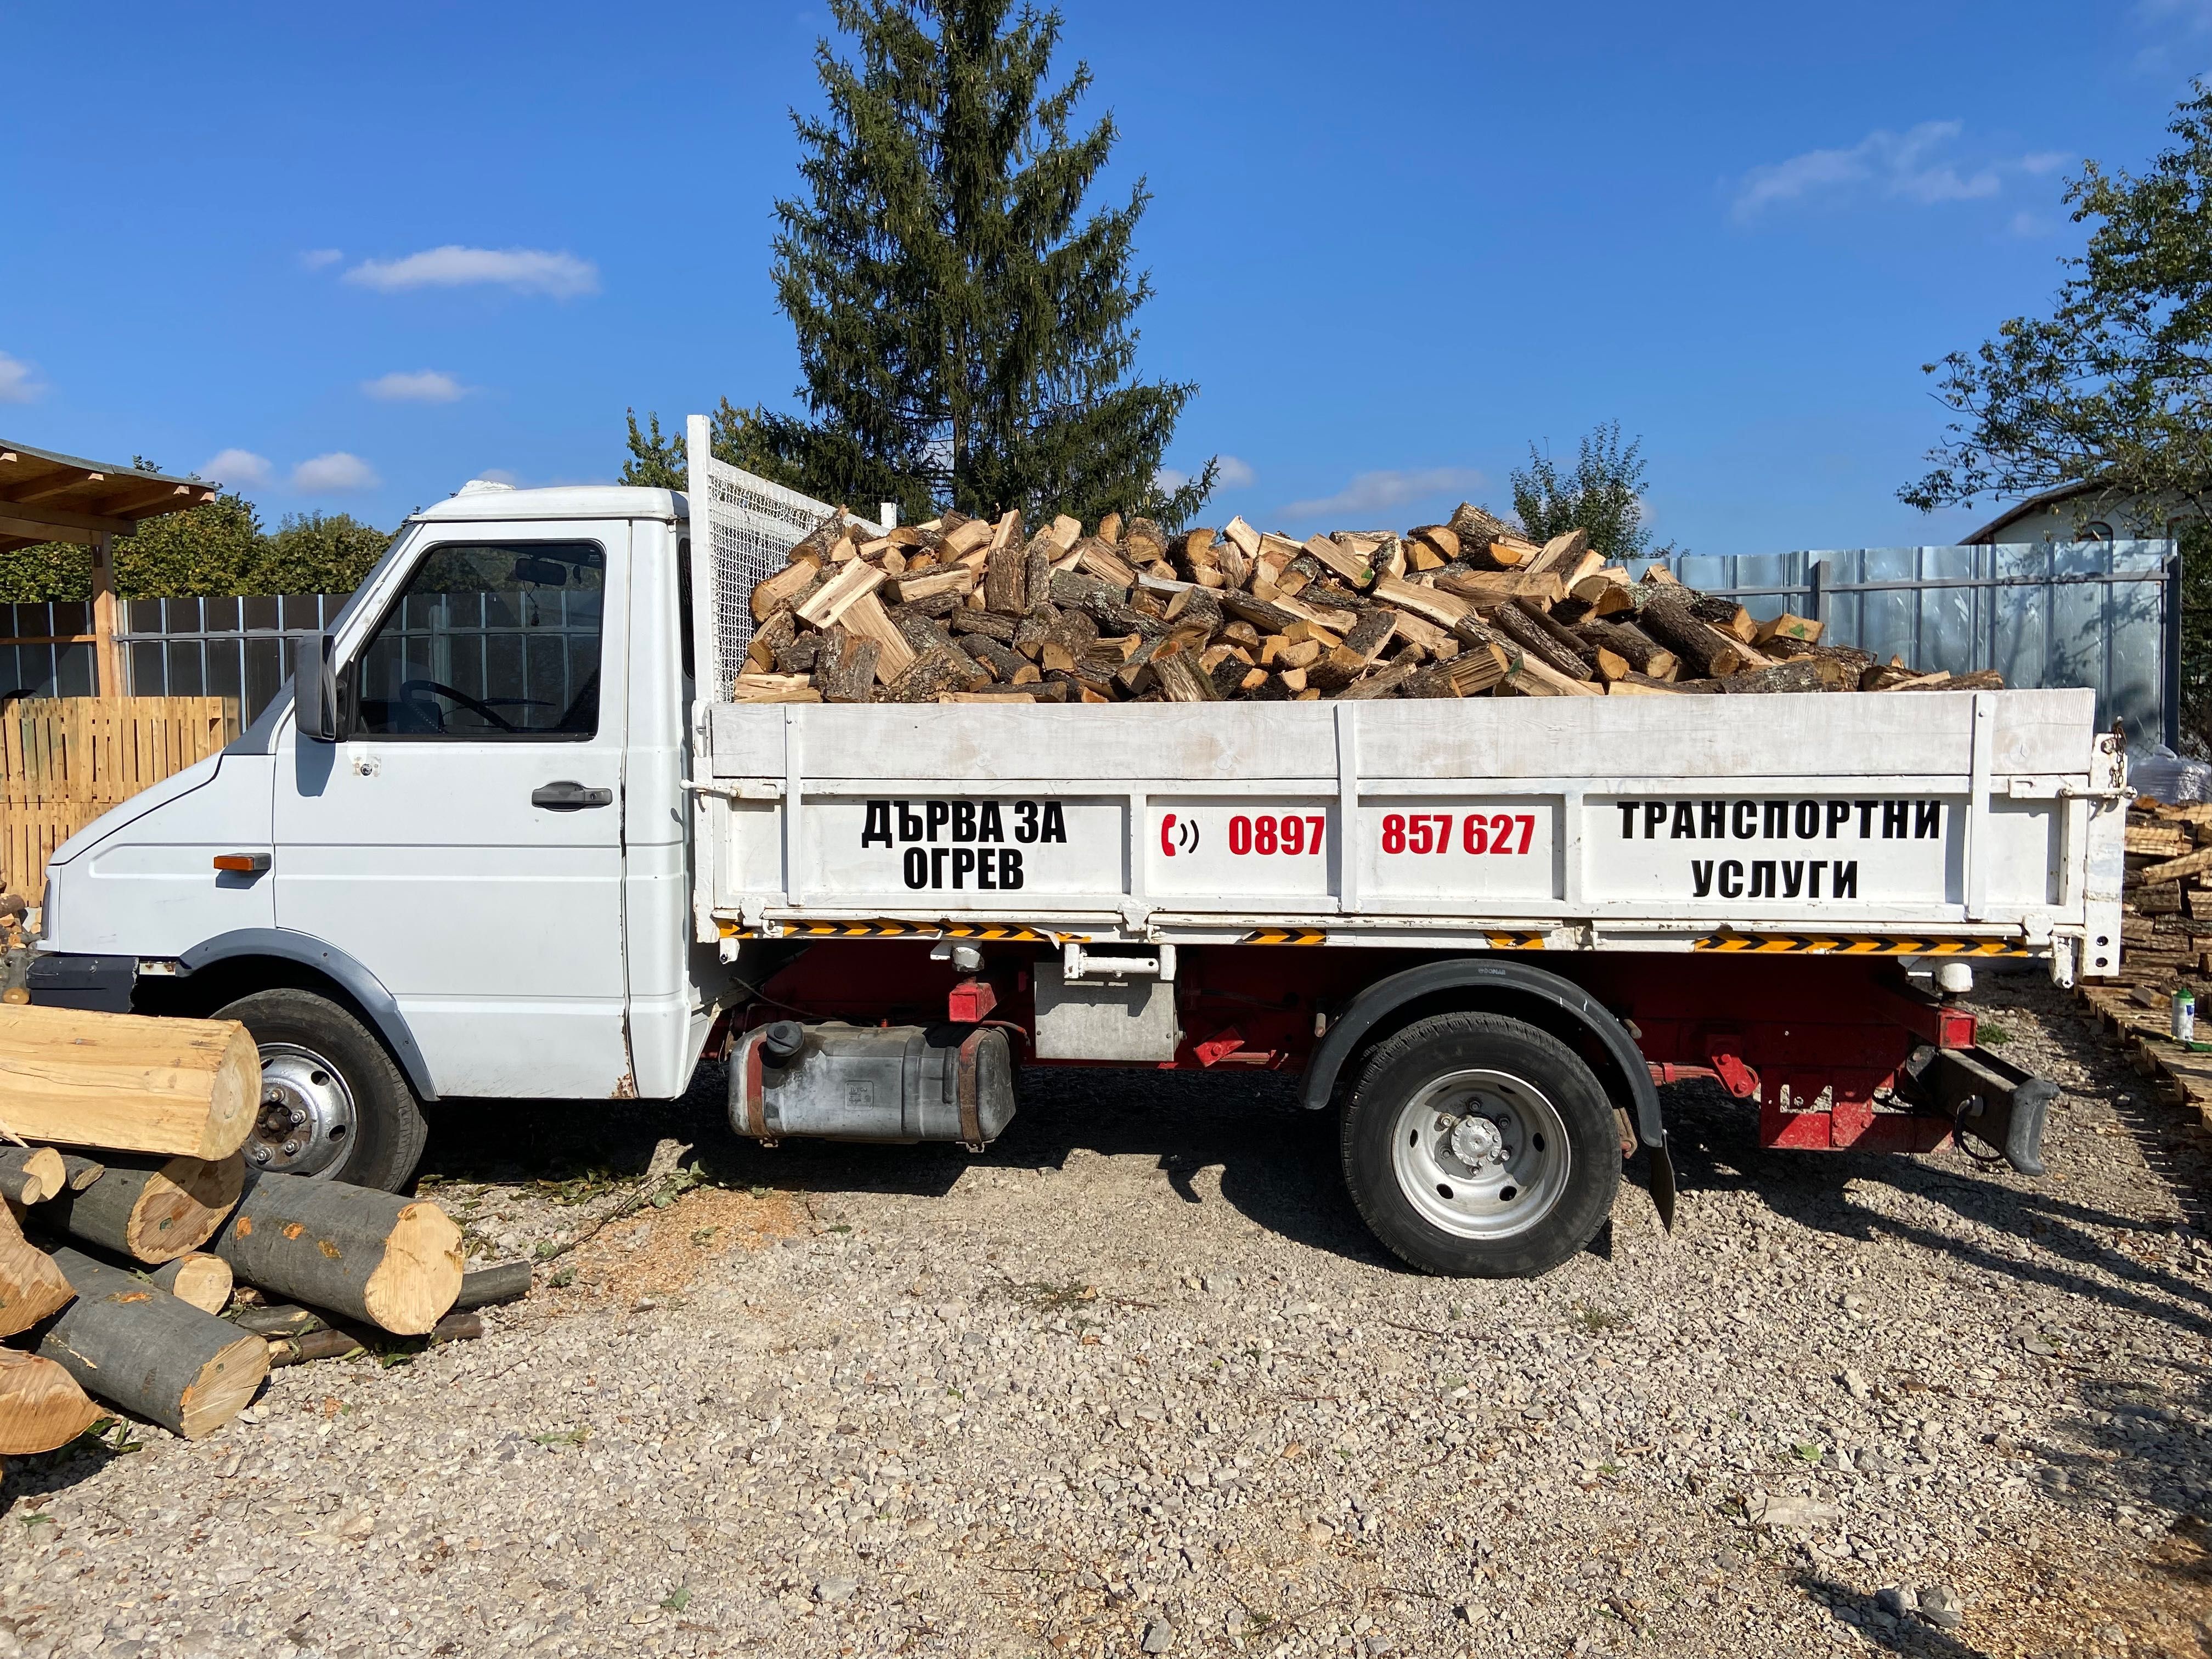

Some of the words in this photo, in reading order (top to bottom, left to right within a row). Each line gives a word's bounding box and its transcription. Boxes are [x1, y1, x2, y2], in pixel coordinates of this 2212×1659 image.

[861, 800, 1005, 849] ДЪРВА
[1014, 800, 1068, 844] ЗА
[1228, 815, 1325, 855] 0897
[1382, 814, 1453, 854] 857
[1463, 814, 1536, 855] 627
[1616, 799, 1942, 839] ТРАНСПОРТНИ
[903, 847, 1024, 890] ОГРЕВ
[1691, 860, 1858, 899] УСЛУГИ
